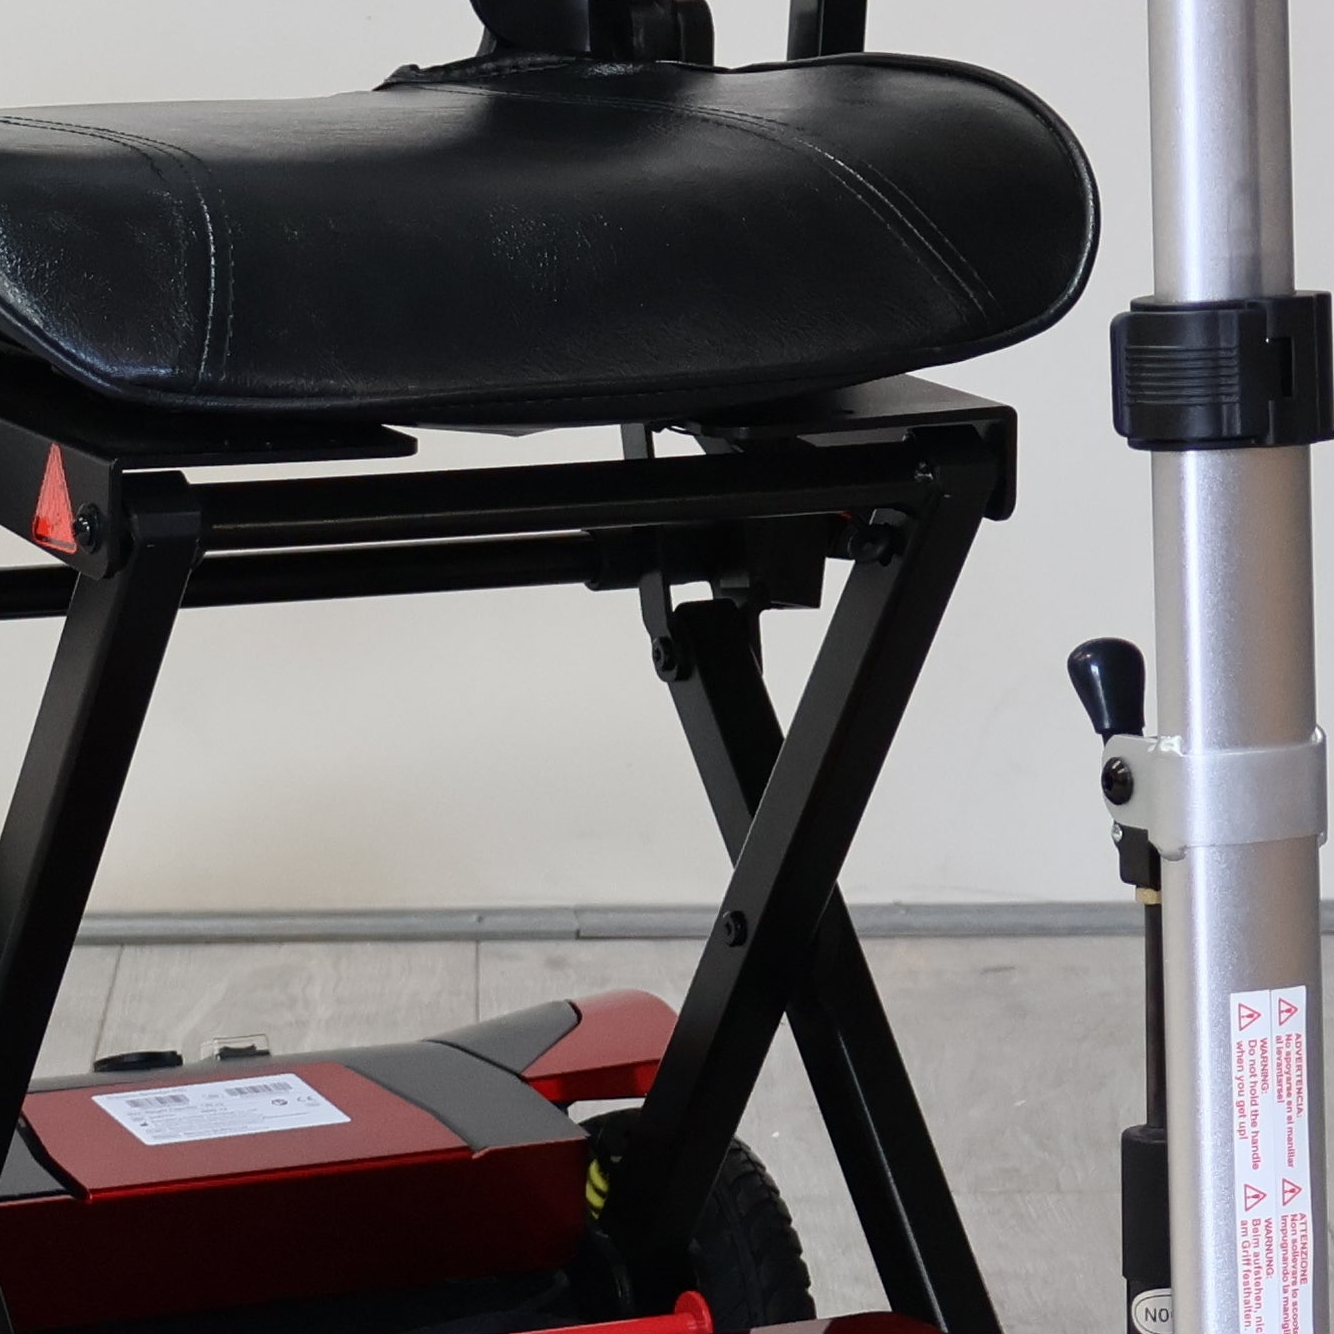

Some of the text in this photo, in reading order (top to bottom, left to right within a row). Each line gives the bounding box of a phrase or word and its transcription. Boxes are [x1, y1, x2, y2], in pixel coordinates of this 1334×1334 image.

[1236, 1040, 1245, 1072] when
[1260, 1037, 1269, 1094] WARNING:
[1235, 1075, 1245, 1097] you
[1236, 1100, 1247, 1118] get
[1248, 1039, 1261, 1170] Do not hold the handle
[1240, 1220, 1248, 1237] am
[1290, 1213, 1298, 1236] Non
[1144, 1306, 1172, 1323] NO
